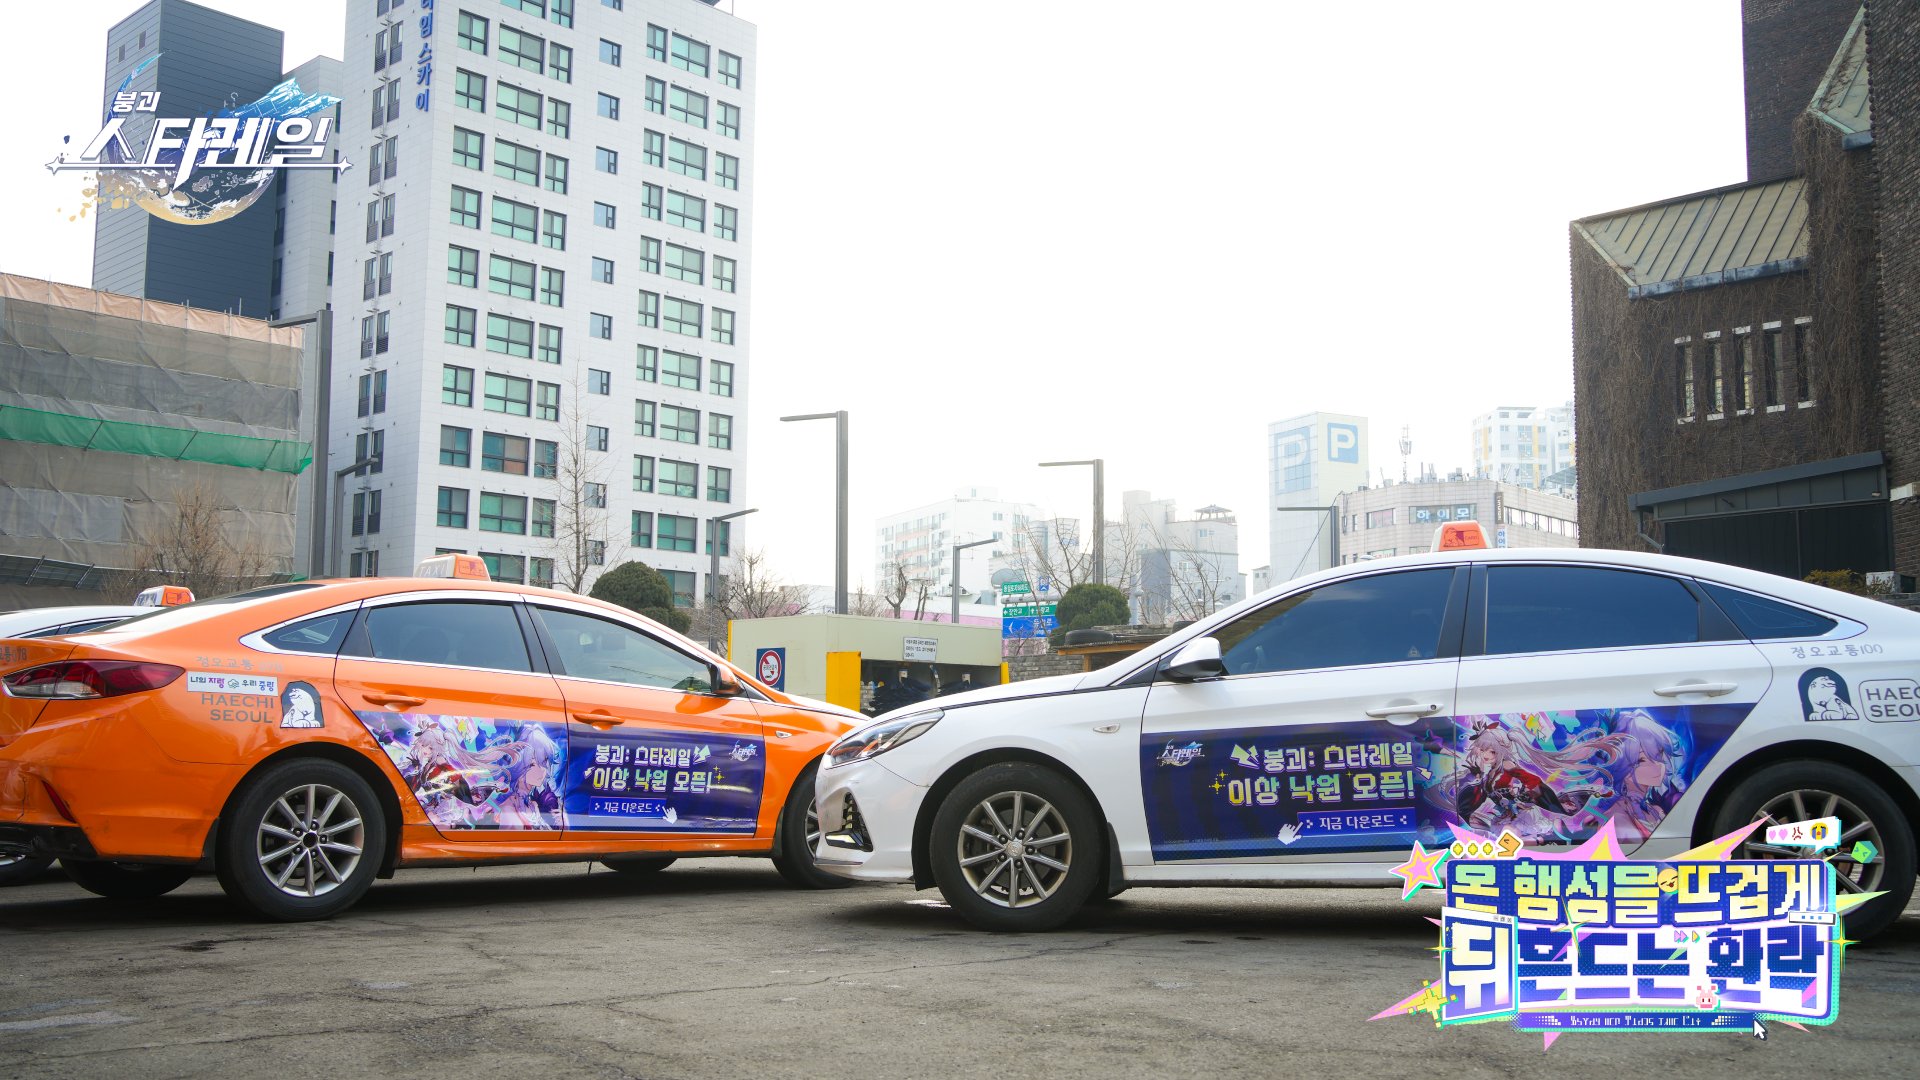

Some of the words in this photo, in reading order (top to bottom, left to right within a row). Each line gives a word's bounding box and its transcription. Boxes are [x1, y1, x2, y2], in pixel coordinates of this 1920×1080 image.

[1416, 507, 1470, 520] 하이모
[190, 676, 206, 684] 나의
[208, 677, 225, 689] 자랑
[242, 679, 257, 687] 우리
[258, 680, 275, 692] 중랑
[201, 694, 275, 709] HAECHI
[210, 709, 273, 723] SEOUL
[595, 744, 630, 765] 붕괴:
[634, 746, 691, 767] 스타레일
[1264, 747, 1316, 772] 붕괴:
[1323, 742, 1413, 770] 스타레일
[593, 767, 630, 791] 이상
[634, 769, 668, 792] 낙원
[672, 771, 712, 794] 오픈!
[1228, 776, 1280, 806] 이상
[1288, 773, 1342, 803] 낙원
[1352, 771, 1416, 800] 오픈!
[604, 802, 619, 813] 지금
[621, 803, 652, 813] 다운로드
[1319, 817, 1342, 830] 지금
[1346, 814, 1395, 829] 다운로드
